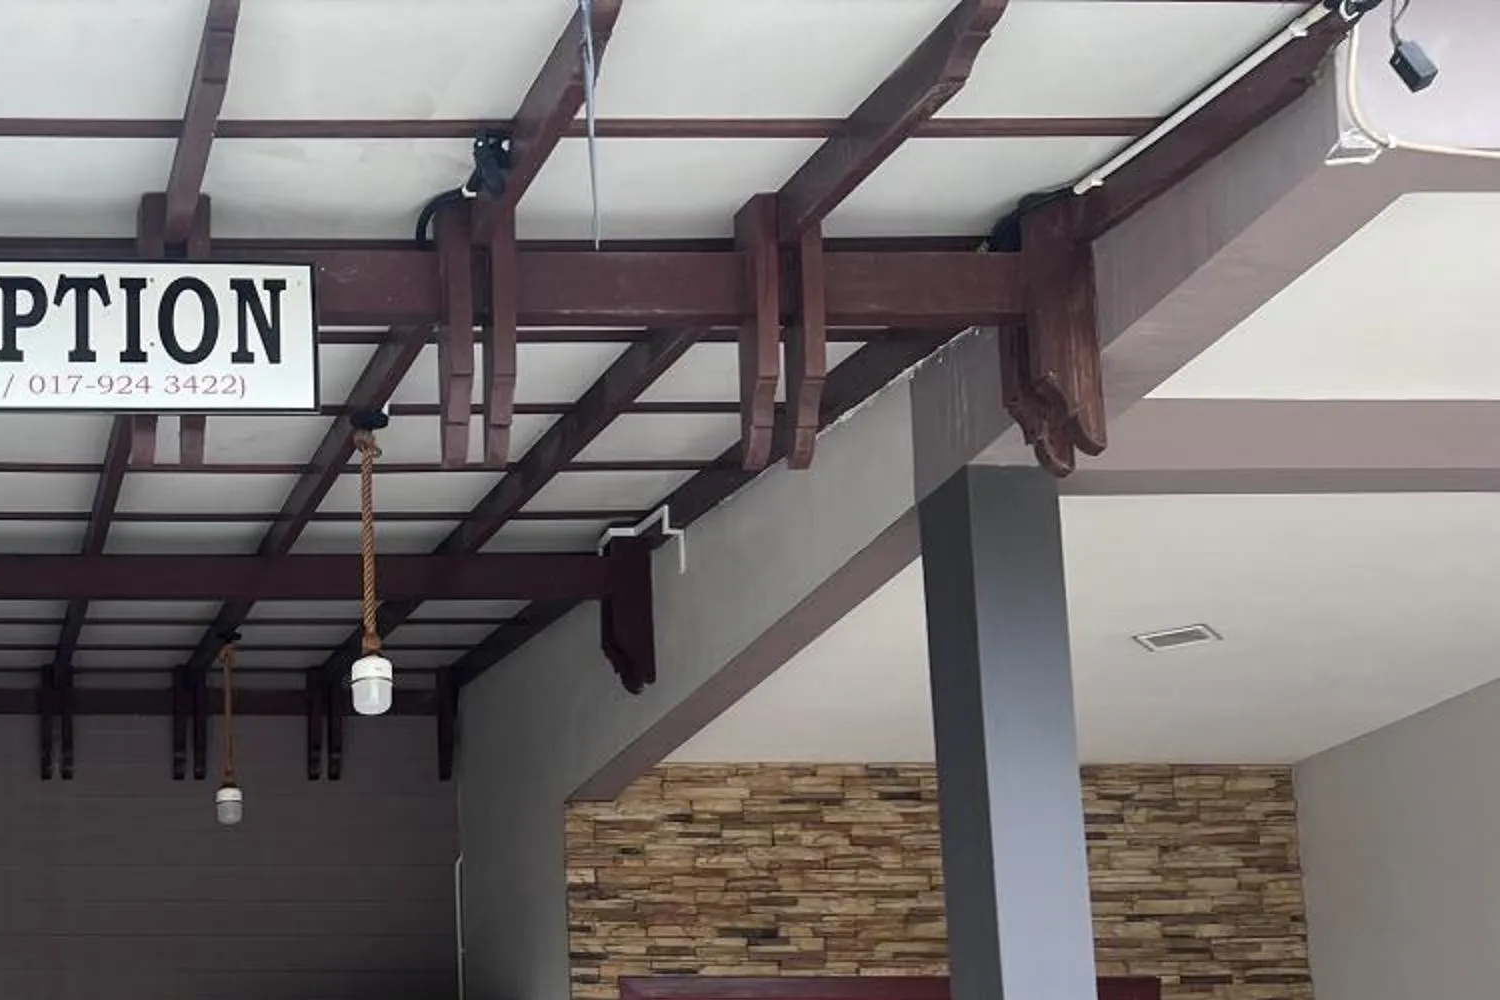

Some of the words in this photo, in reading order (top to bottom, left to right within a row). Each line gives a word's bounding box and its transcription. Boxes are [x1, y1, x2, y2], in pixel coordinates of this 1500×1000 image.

[2, 373, 15, 399] /
[29, 375, 153, 396] 017-924
[163, 374, 247, 399] 3422)
